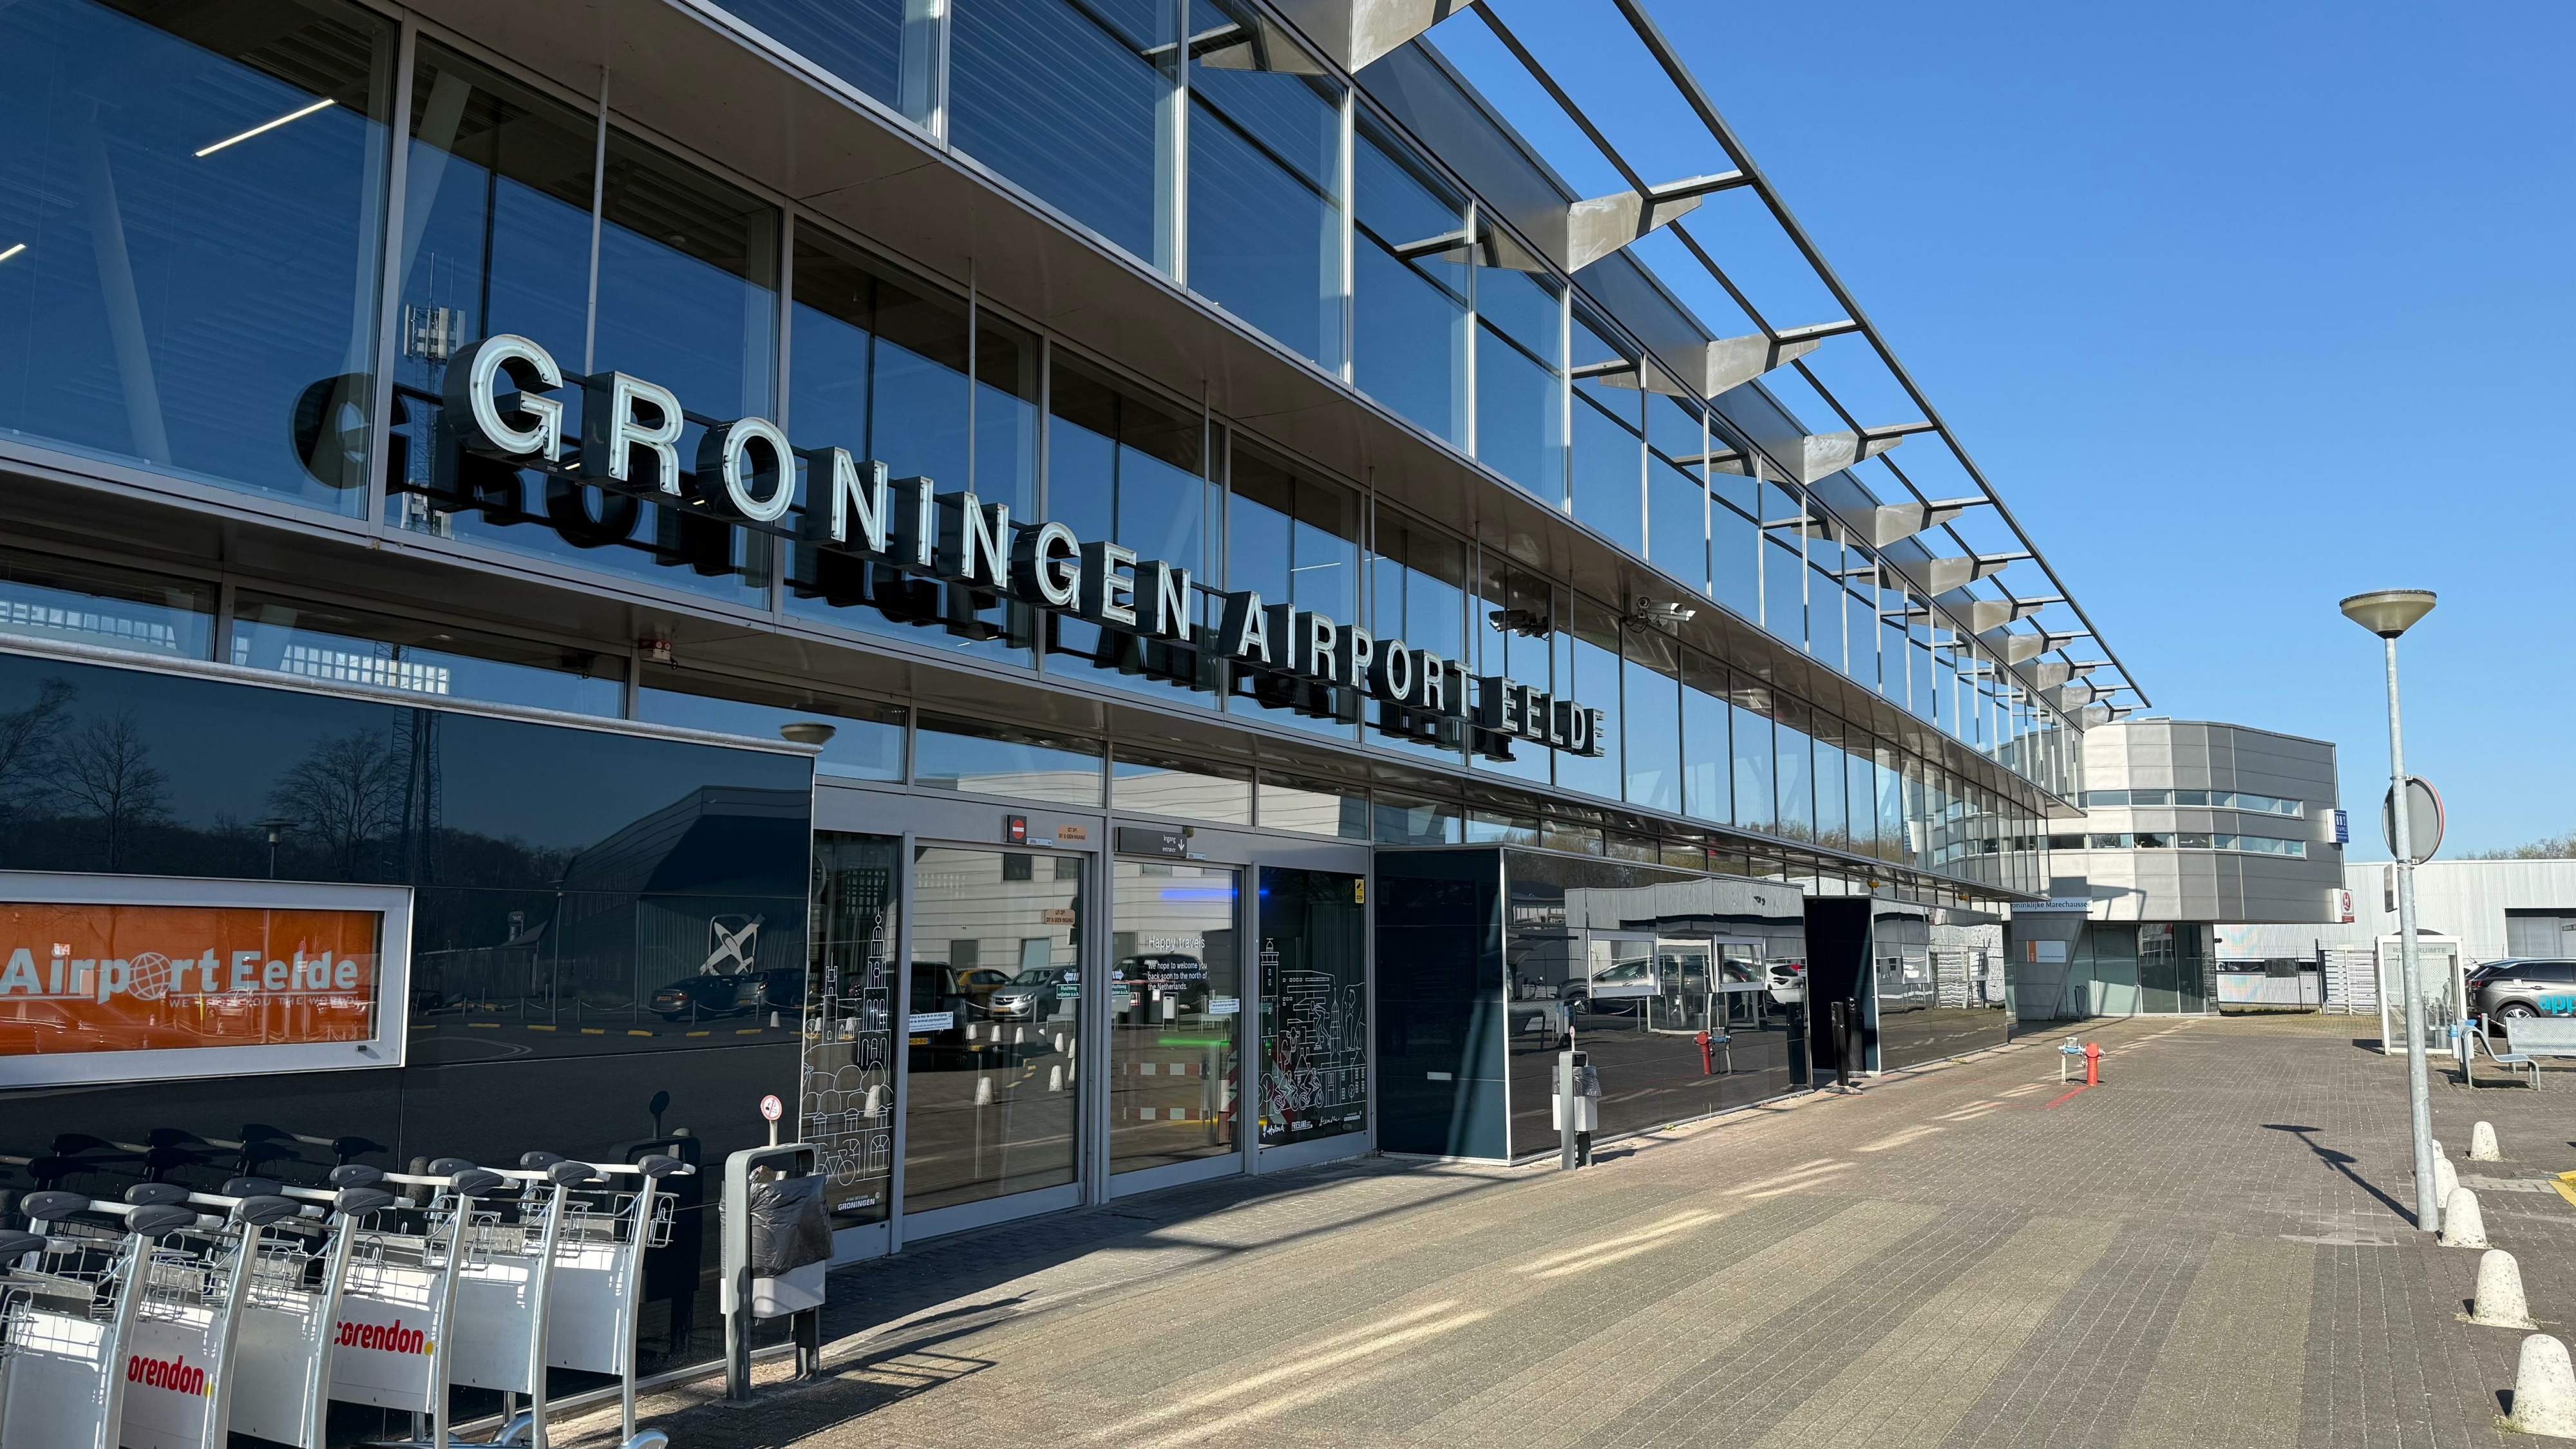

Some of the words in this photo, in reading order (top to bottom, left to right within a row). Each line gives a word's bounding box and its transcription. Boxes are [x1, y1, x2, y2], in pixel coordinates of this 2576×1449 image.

[470, 334, 1191, 641] GRONINGEN
[1238, 591, 1472, 717] AIRPORT
[1502, 677, 1605, 757] EELDE
[1164, 835, 1176, 844] Ingang
[1149, 934, 1175, 951] Happy
[1179, 935, 1205, 949] travels
[231, 950, 359, 990] Eelde
[1157, 961, 1170, 971] hope
[1148, 971, 1160, 980] back
[1148, 983, 1156, 991] the
[1157, 982, 1188, 990] Netherlands.
[169, 999, 189, 1009] WE
[245, 997, 271, 1006] YOU
[278, 997, 303, 1006] THE
[838, 1198, 875, 1211] GRONINGEN
[126, 1355, 204, 1396] orendon
